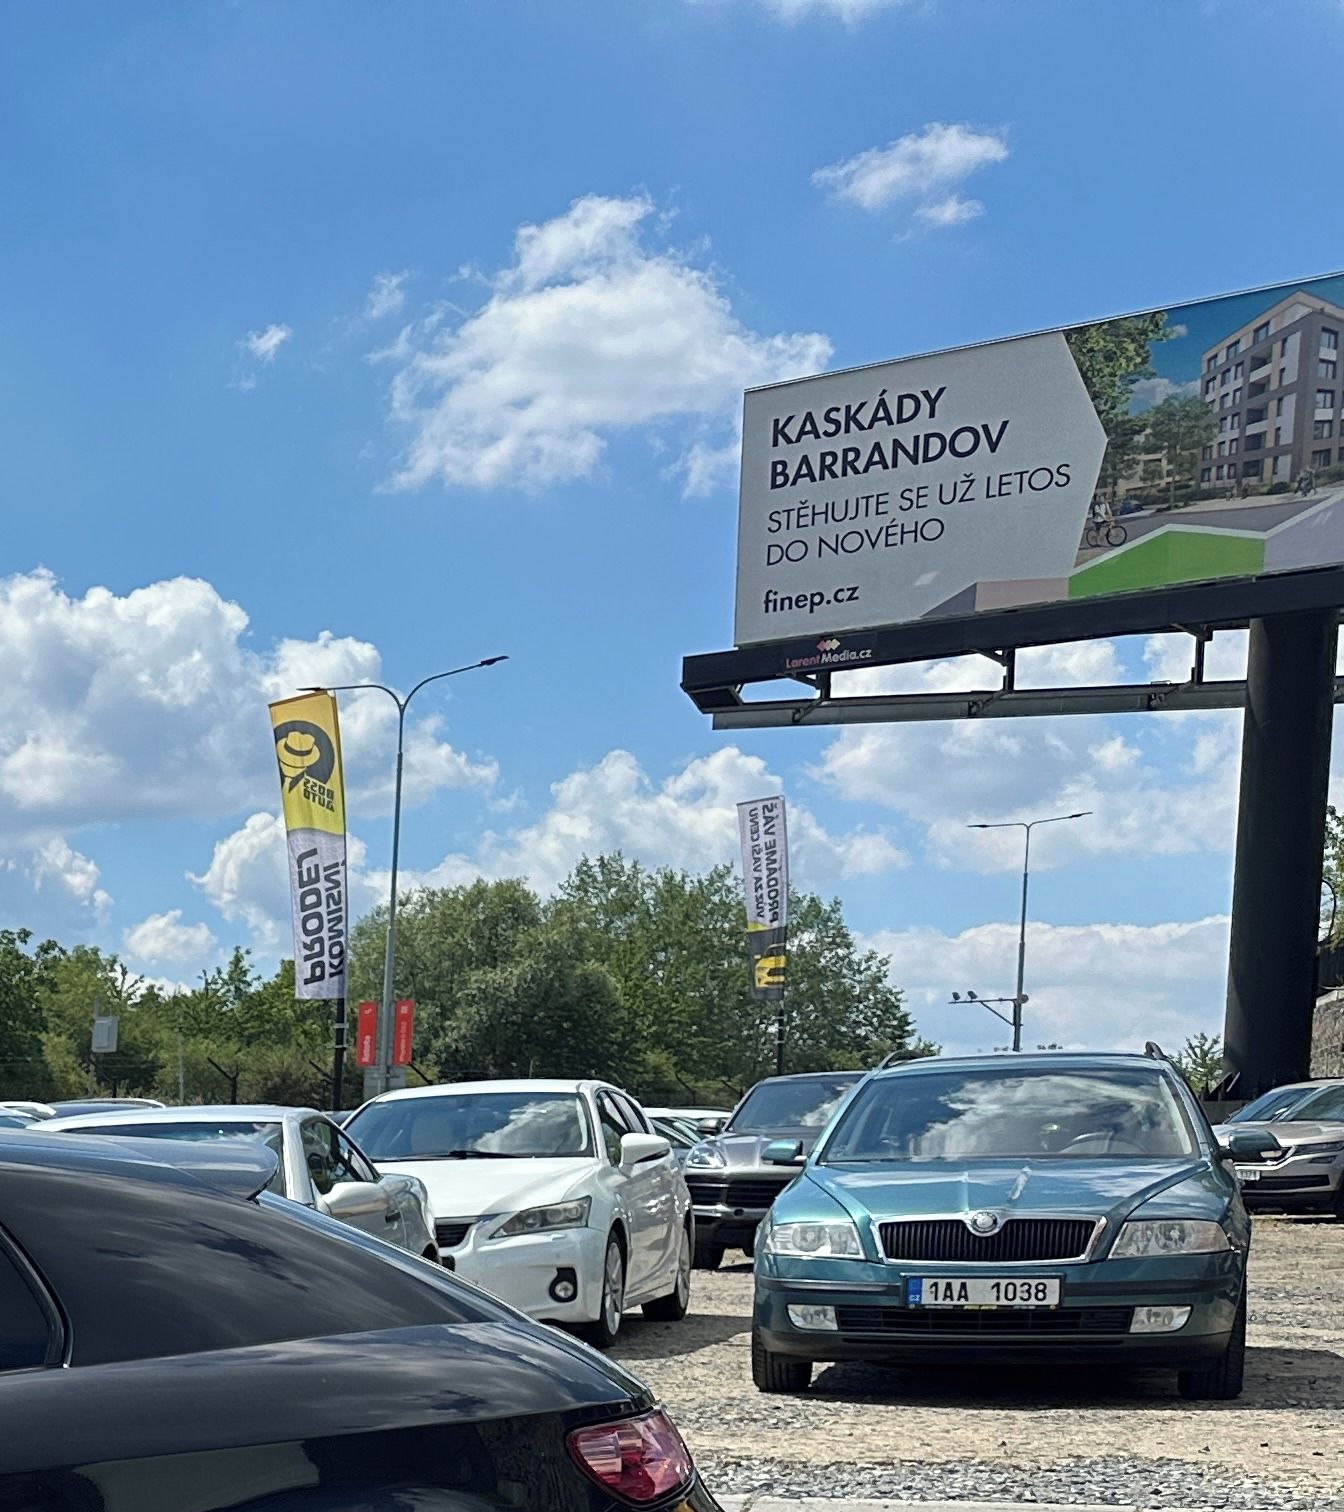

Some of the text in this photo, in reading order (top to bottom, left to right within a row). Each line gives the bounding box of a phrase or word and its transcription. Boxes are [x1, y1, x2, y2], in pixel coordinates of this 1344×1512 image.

[771, 386, 947, 447] KASKÁDY
[770, 419, 1010, 490] BARRANDOV
[767, 463, 1071, 533] STĚHUJTE SE UŽ LETOS
[766, 518, 945, 566] DO NOVÉHO
[763, 585, 860, 614] finep.cz
[929, 1281, 969, 1302] 1AA
[990, 1281, 1048, 1302] 1038
